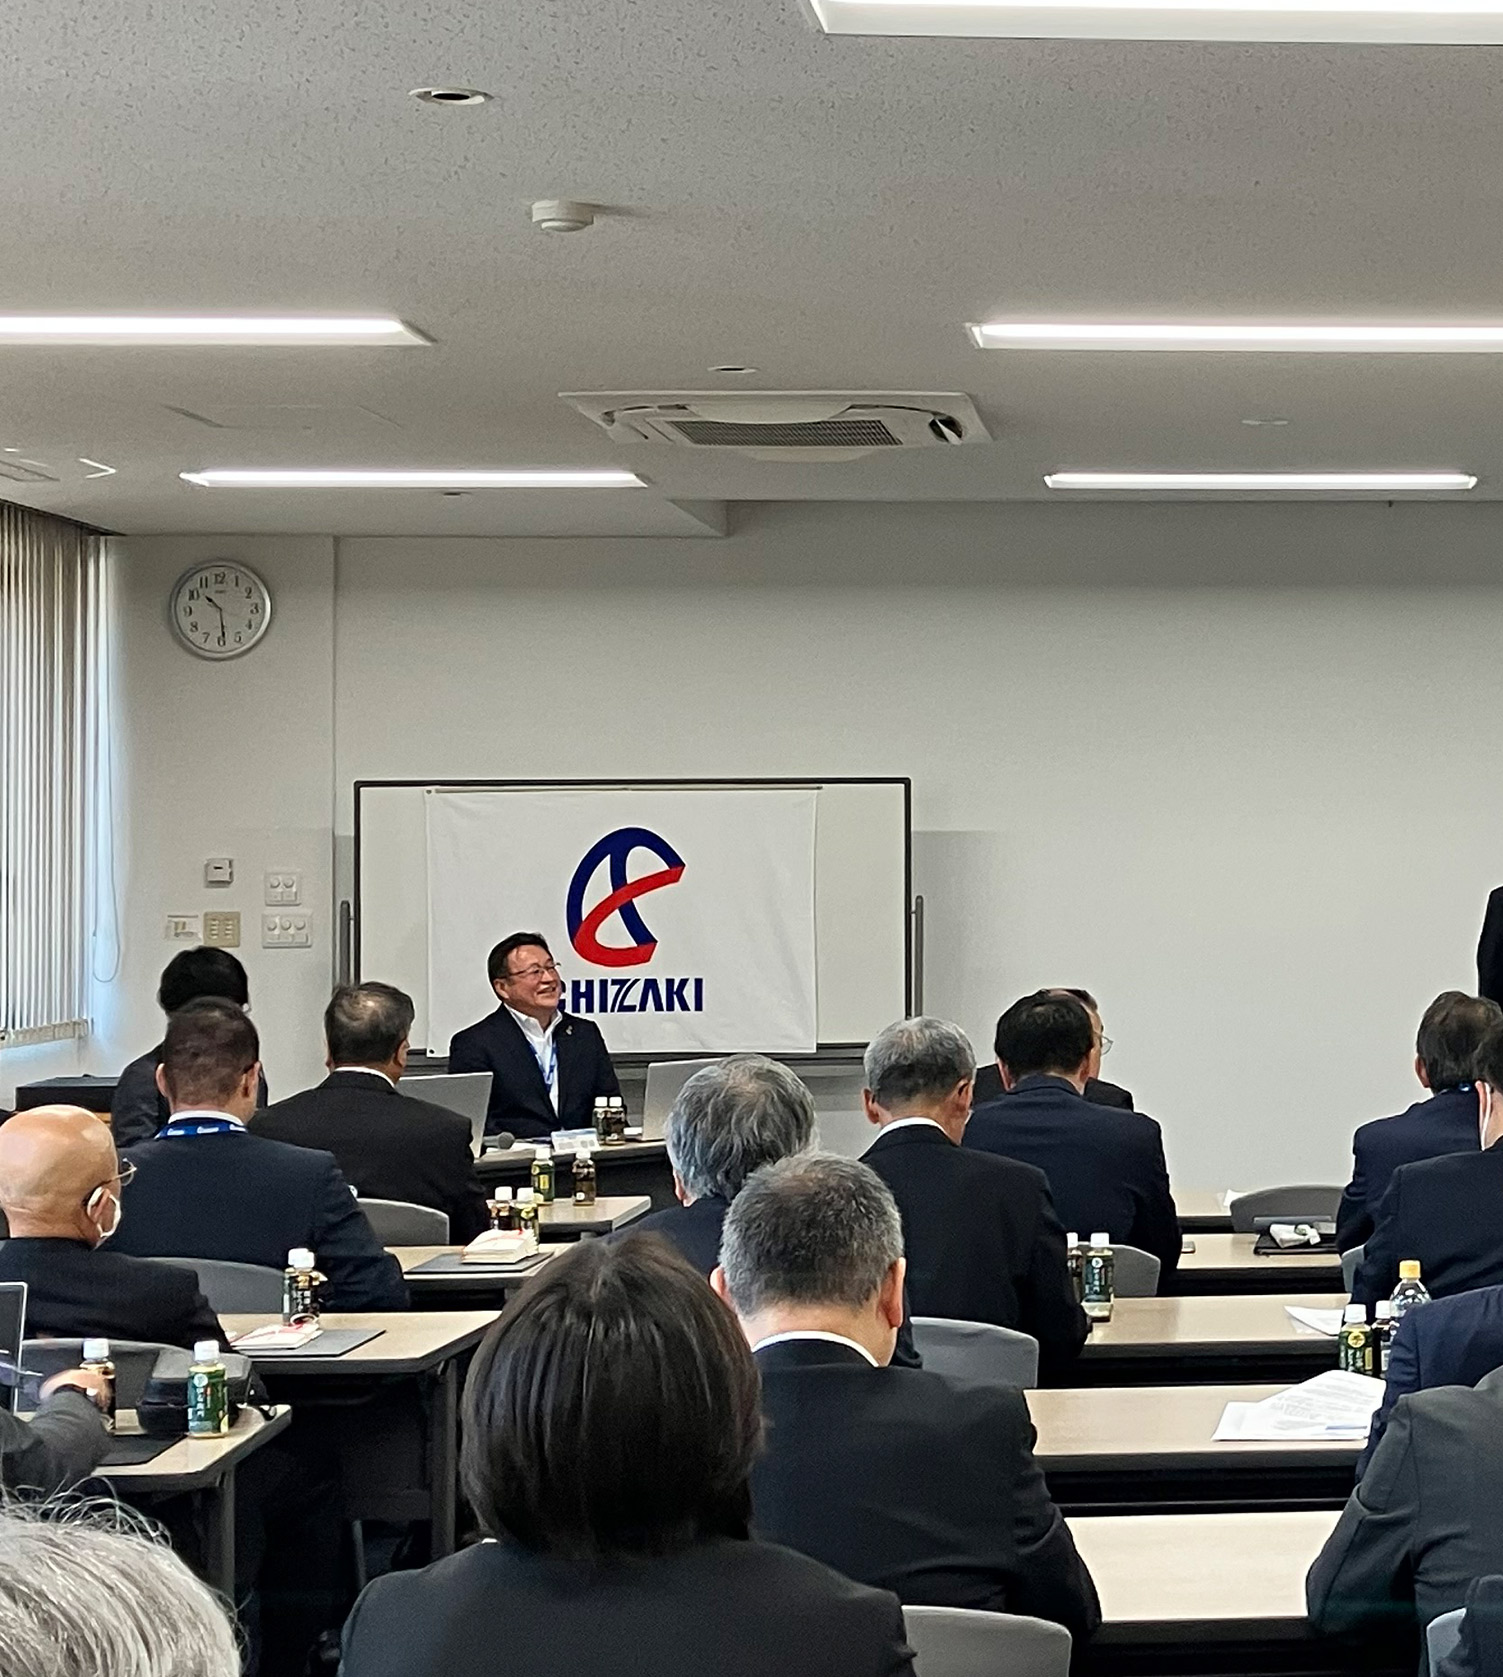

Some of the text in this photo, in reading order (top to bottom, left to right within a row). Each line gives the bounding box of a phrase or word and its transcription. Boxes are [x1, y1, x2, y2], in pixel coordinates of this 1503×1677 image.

[199, 576, 208, 588] 11
[244, 587, 252, 599] 2
[249, 603, 259, 615] 3
[190, 621, 198, 632] 8
[201, 632, 211, 643] 7
